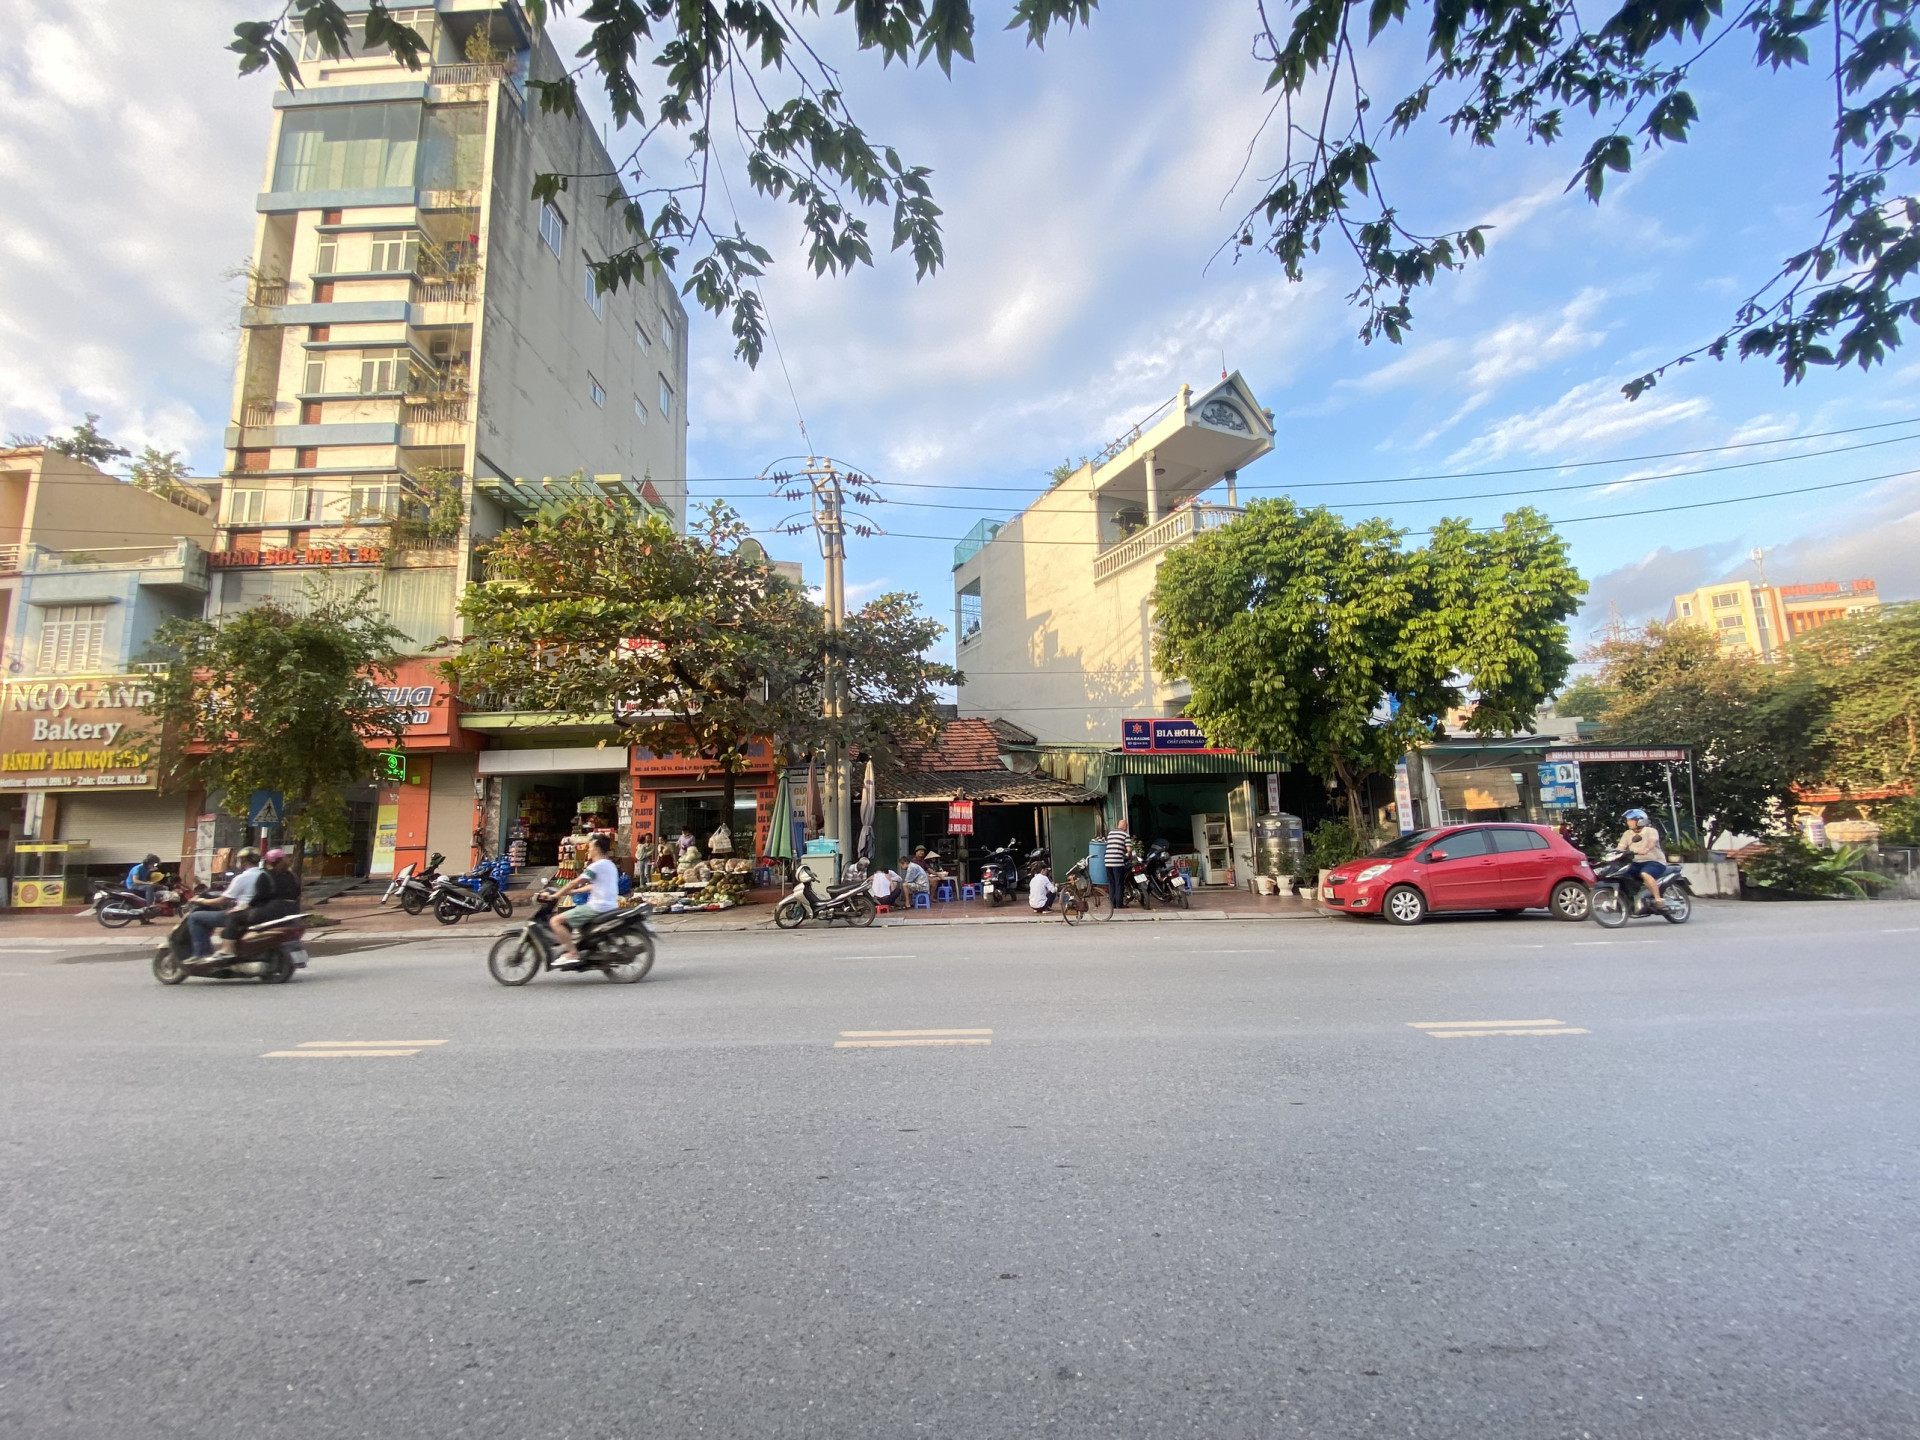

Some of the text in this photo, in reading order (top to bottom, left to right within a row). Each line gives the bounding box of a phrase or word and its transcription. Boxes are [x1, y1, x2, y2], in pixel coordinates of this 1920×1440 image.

[9, 682, 87, 717] NGỌC
[32, 717, 123, 746] Bakery
[1156, 729, 1173, 737] BIA
[635, 807, 653, 816] PLASTIC
